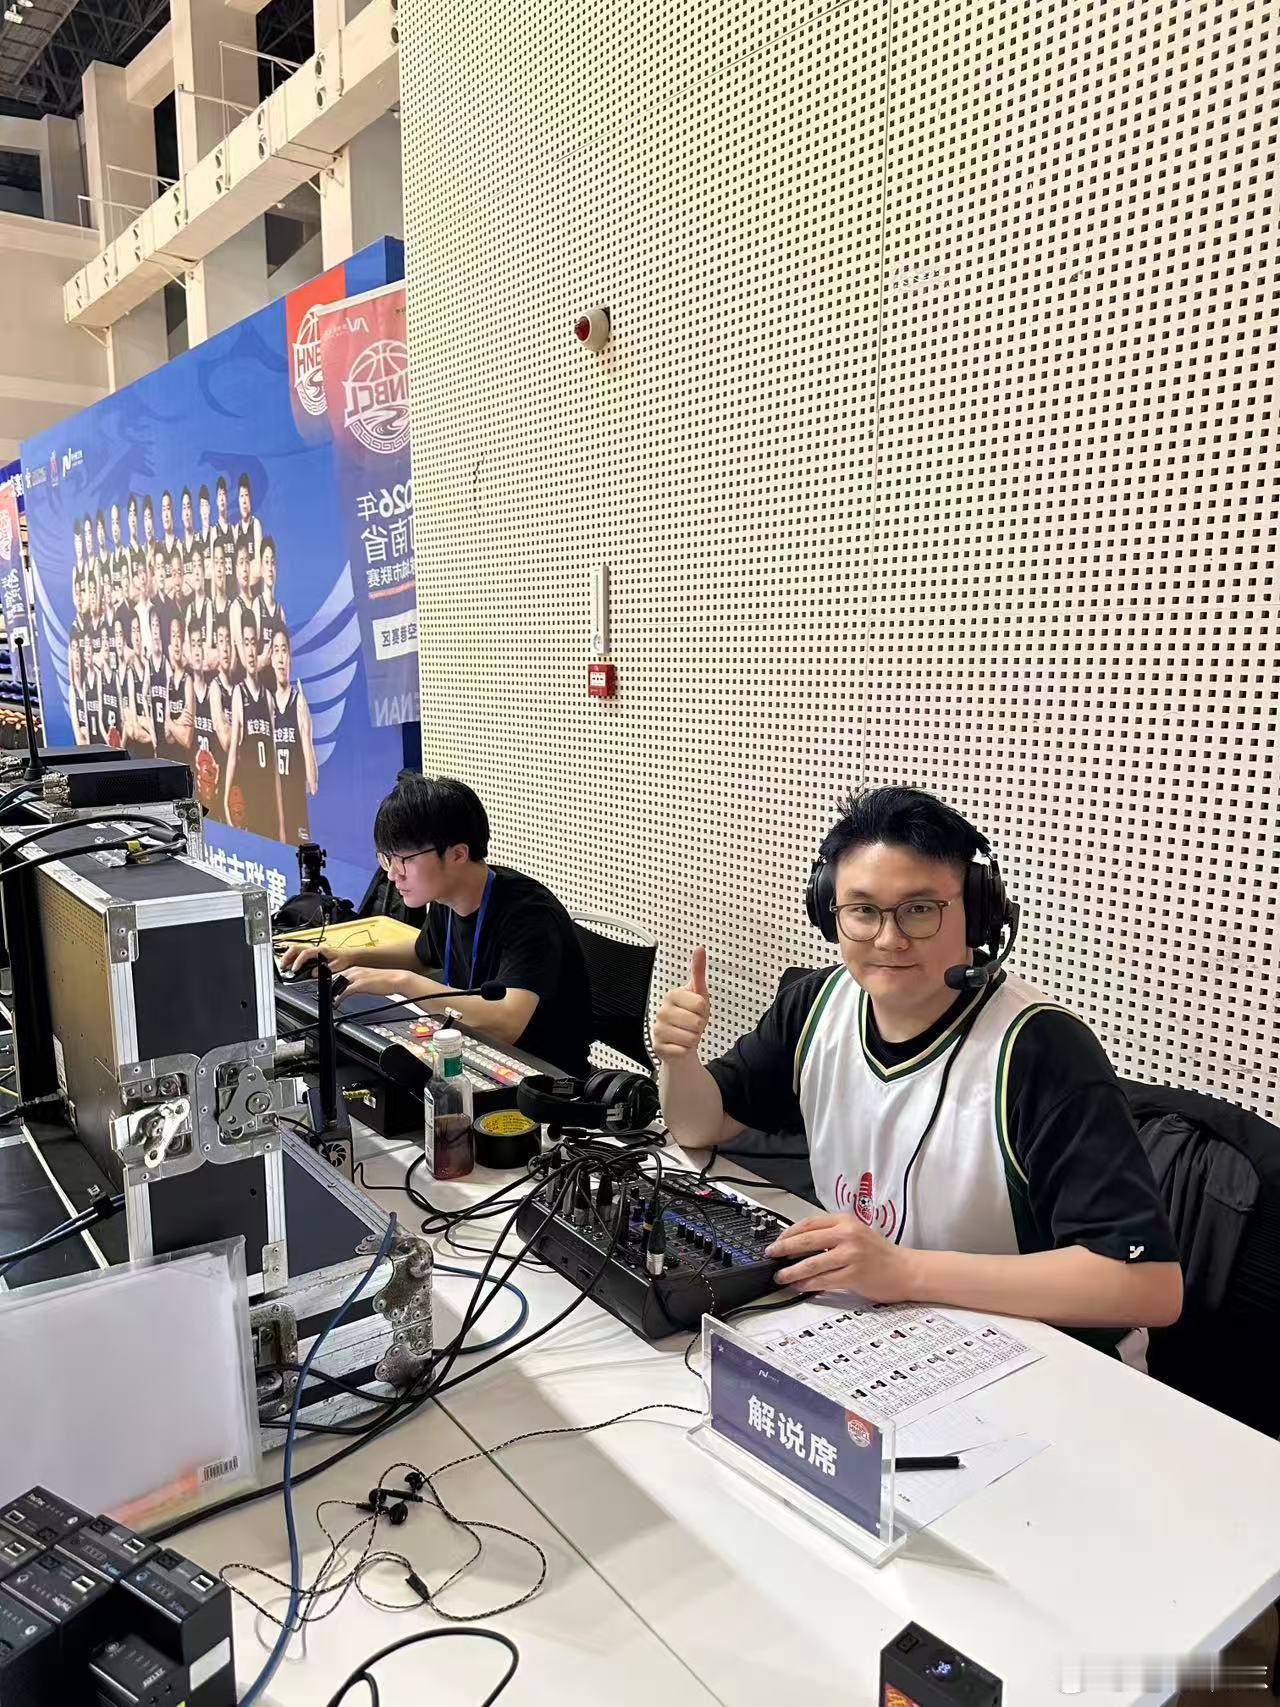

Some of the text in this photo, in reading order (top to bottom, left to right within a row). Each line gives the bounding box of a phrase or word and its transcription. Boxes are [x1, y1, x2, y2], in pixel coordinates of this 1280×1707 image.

[258, 741, 266, 768] 0
[277, 749, 289, 775] 67
[204, 843, 287, 909] 城市联赛
[748, 1395, 837, 1476] 解说席
